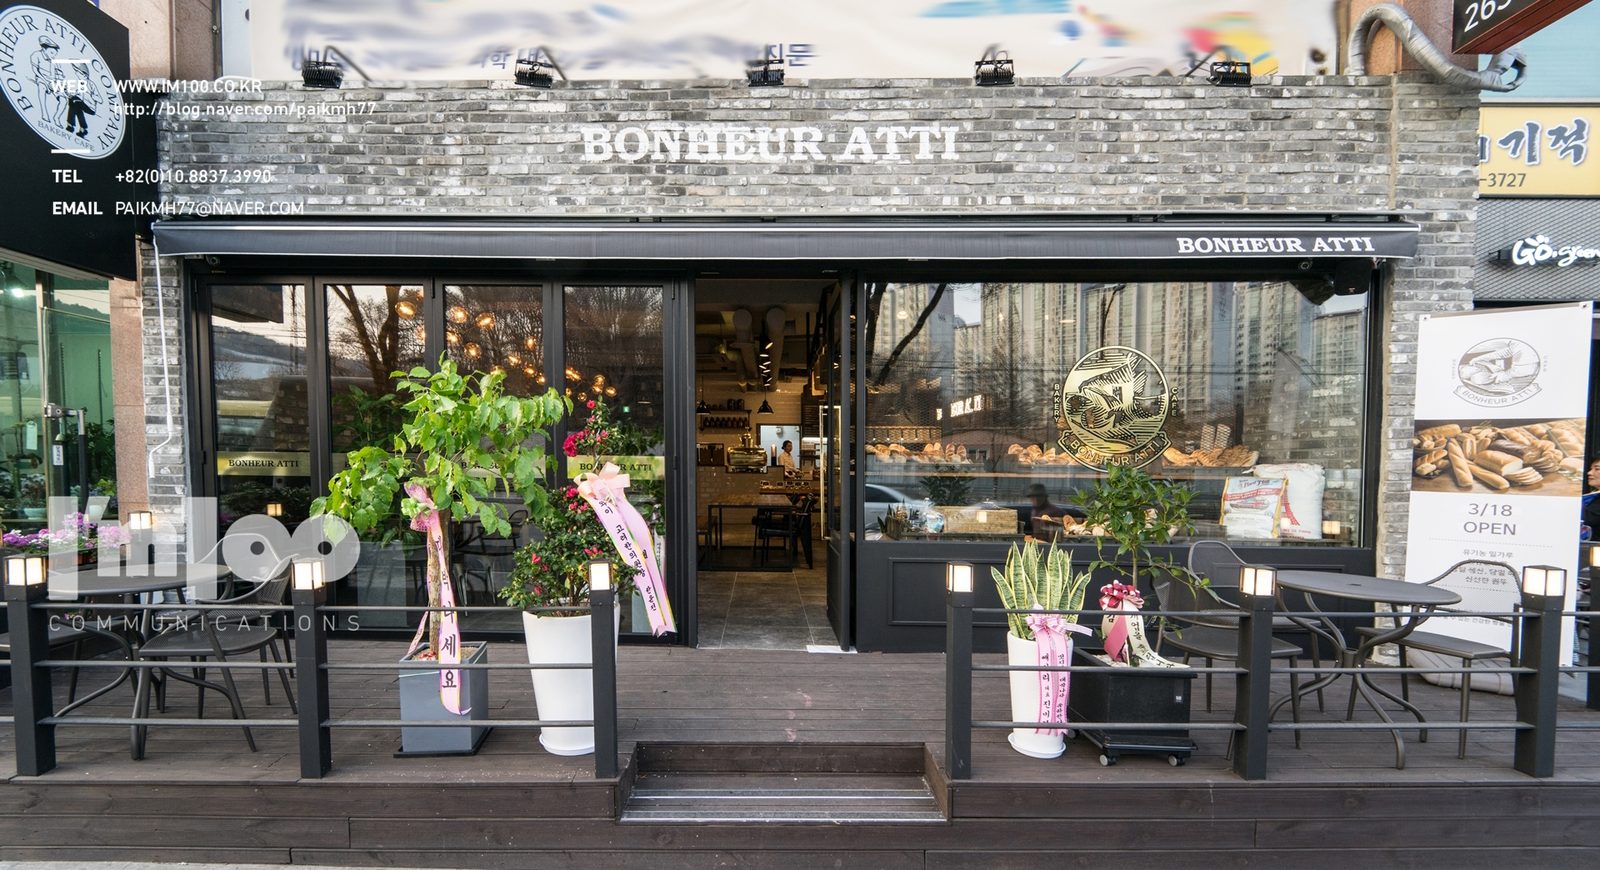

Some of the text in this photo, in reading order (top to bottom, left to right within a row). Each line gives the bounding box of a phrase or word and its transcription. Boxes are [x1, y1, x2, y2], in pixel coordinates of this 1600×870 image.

[0, 14, 121, 150] BONHEUR ATTI COMPANY
[37, 120, 73, 142] BAKERY
[1499, 118, 1589, 165] 기적
[580, 126, 960, 161] BONHEUR ATTI
[1177, 237, 1375, 253] BONHEUR ATTI
[1053, 383, 1061, 422] BAKERY
[1171, 387, 1179, 417] CAFE
[1462, 388, 1533, 405] BONHEUR ATTI
[229, 459, 299, 468] BONHEUR ATTI
[1070, 440, 1160, 466] BONHEUR ATTI
[629, 463, 652, 471] ATTI
[1468, 503, 1513, 517] 3/18
[1463, 522, 1516, 536] OPEN
